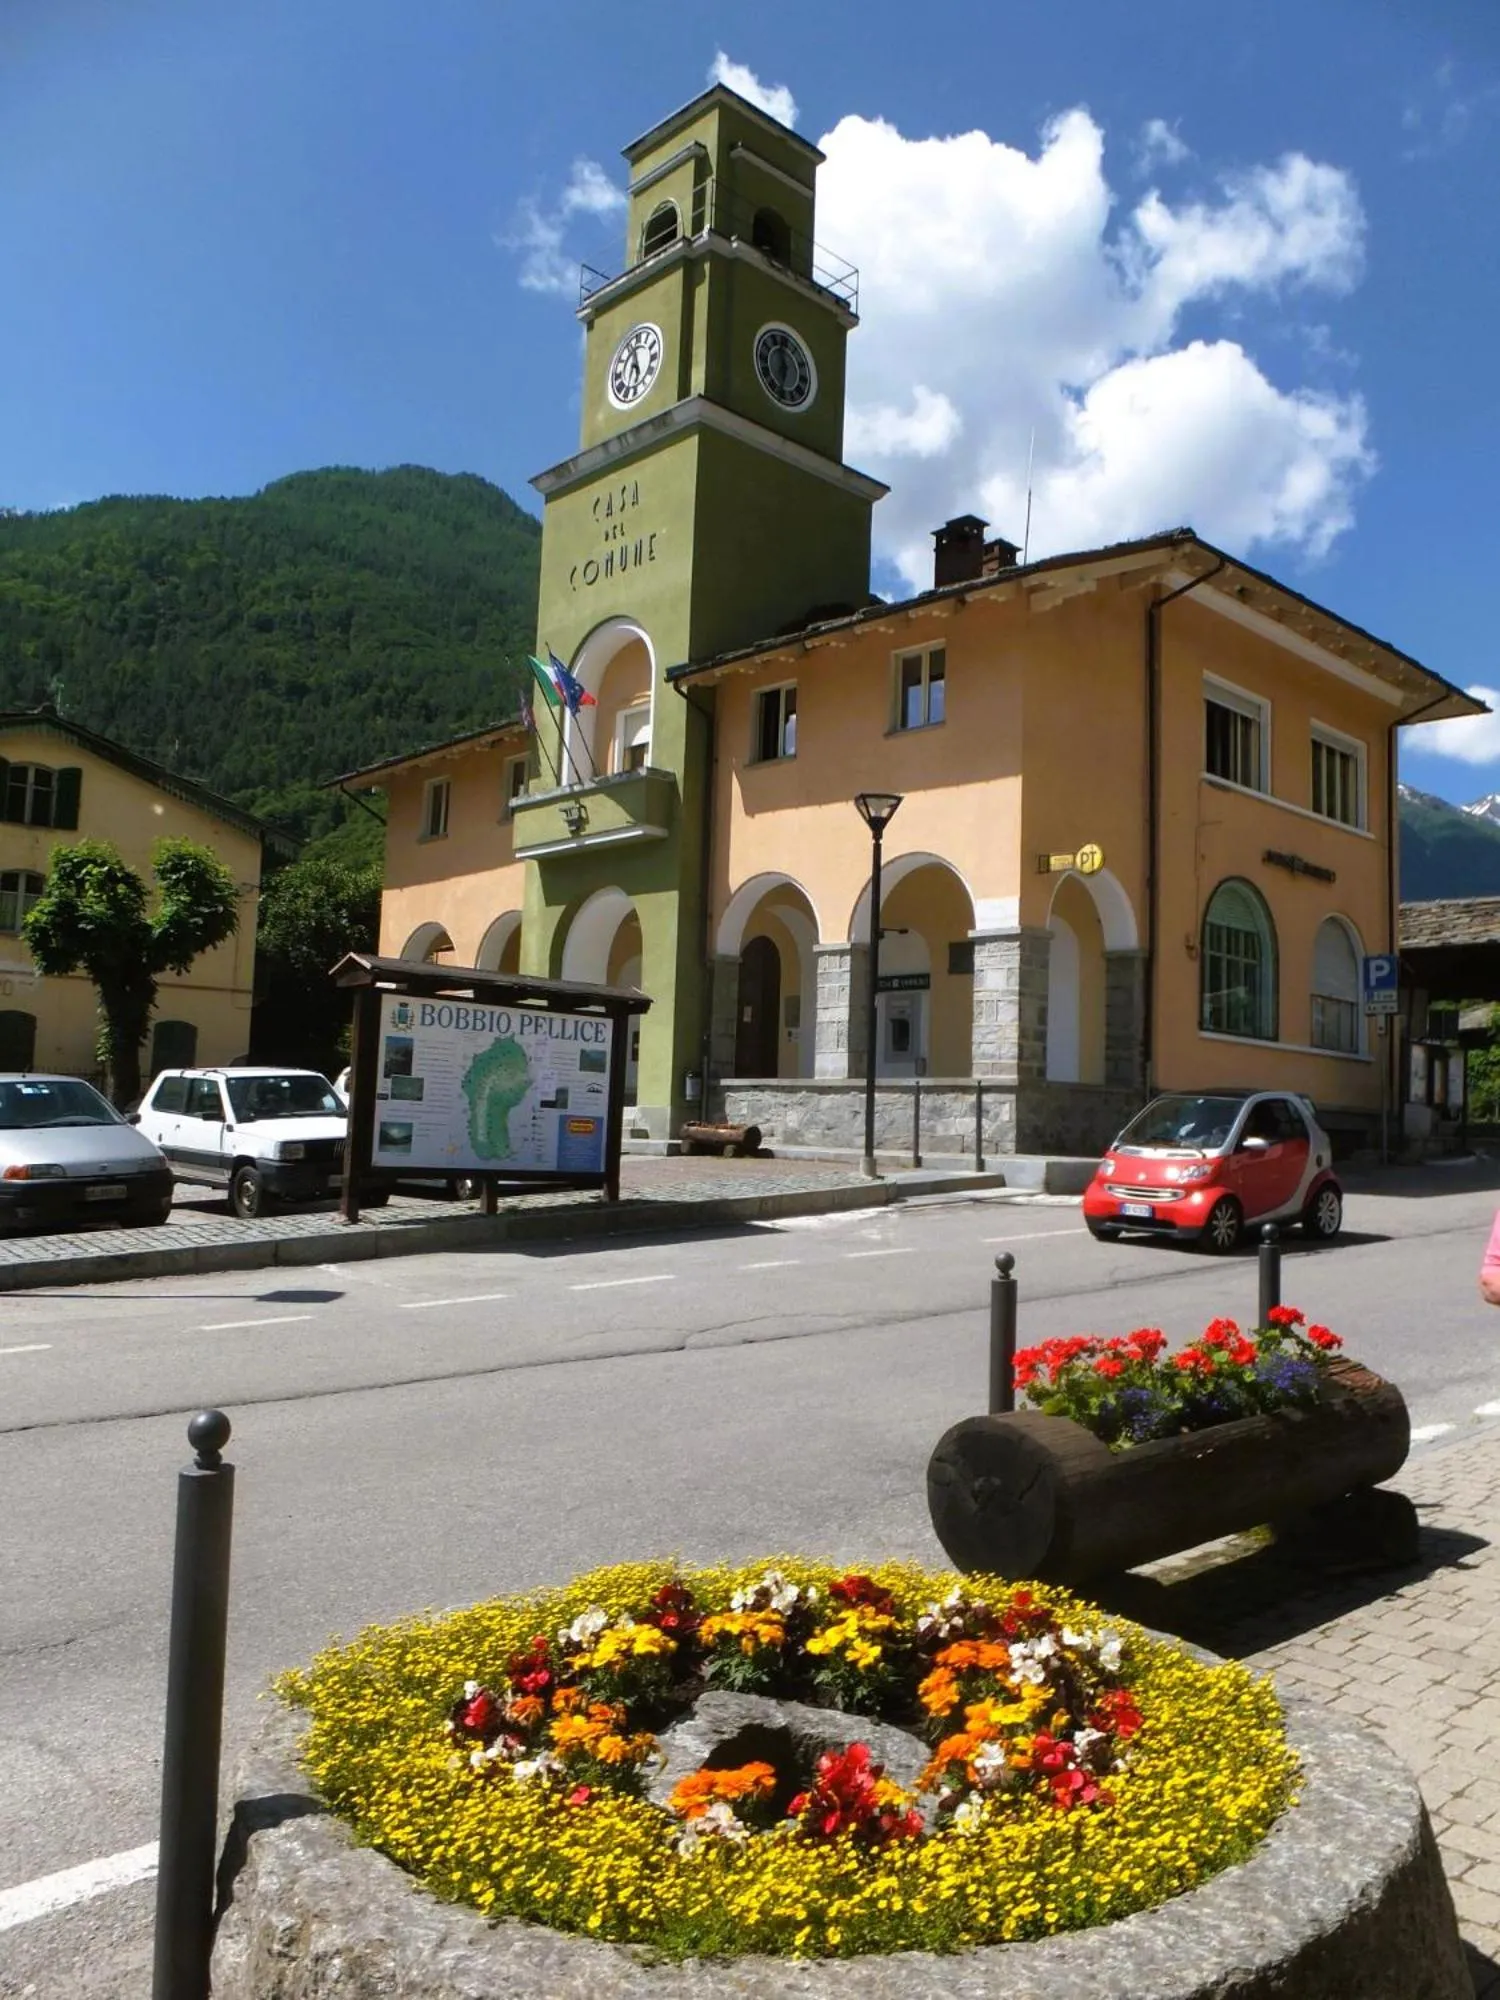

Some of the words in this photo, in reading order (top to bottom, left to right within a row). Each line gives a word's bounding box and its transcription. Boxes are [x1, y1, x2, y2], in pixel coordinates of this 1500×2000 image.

[592, 480, 639, 523] CASA
[570, 533, 657, 592] COMUNE
[1370, 959, 1391, 987] P
[420, 1003, 512, 1034] BOBBIO
[519, 1013, 607, 1044] PELLICE
